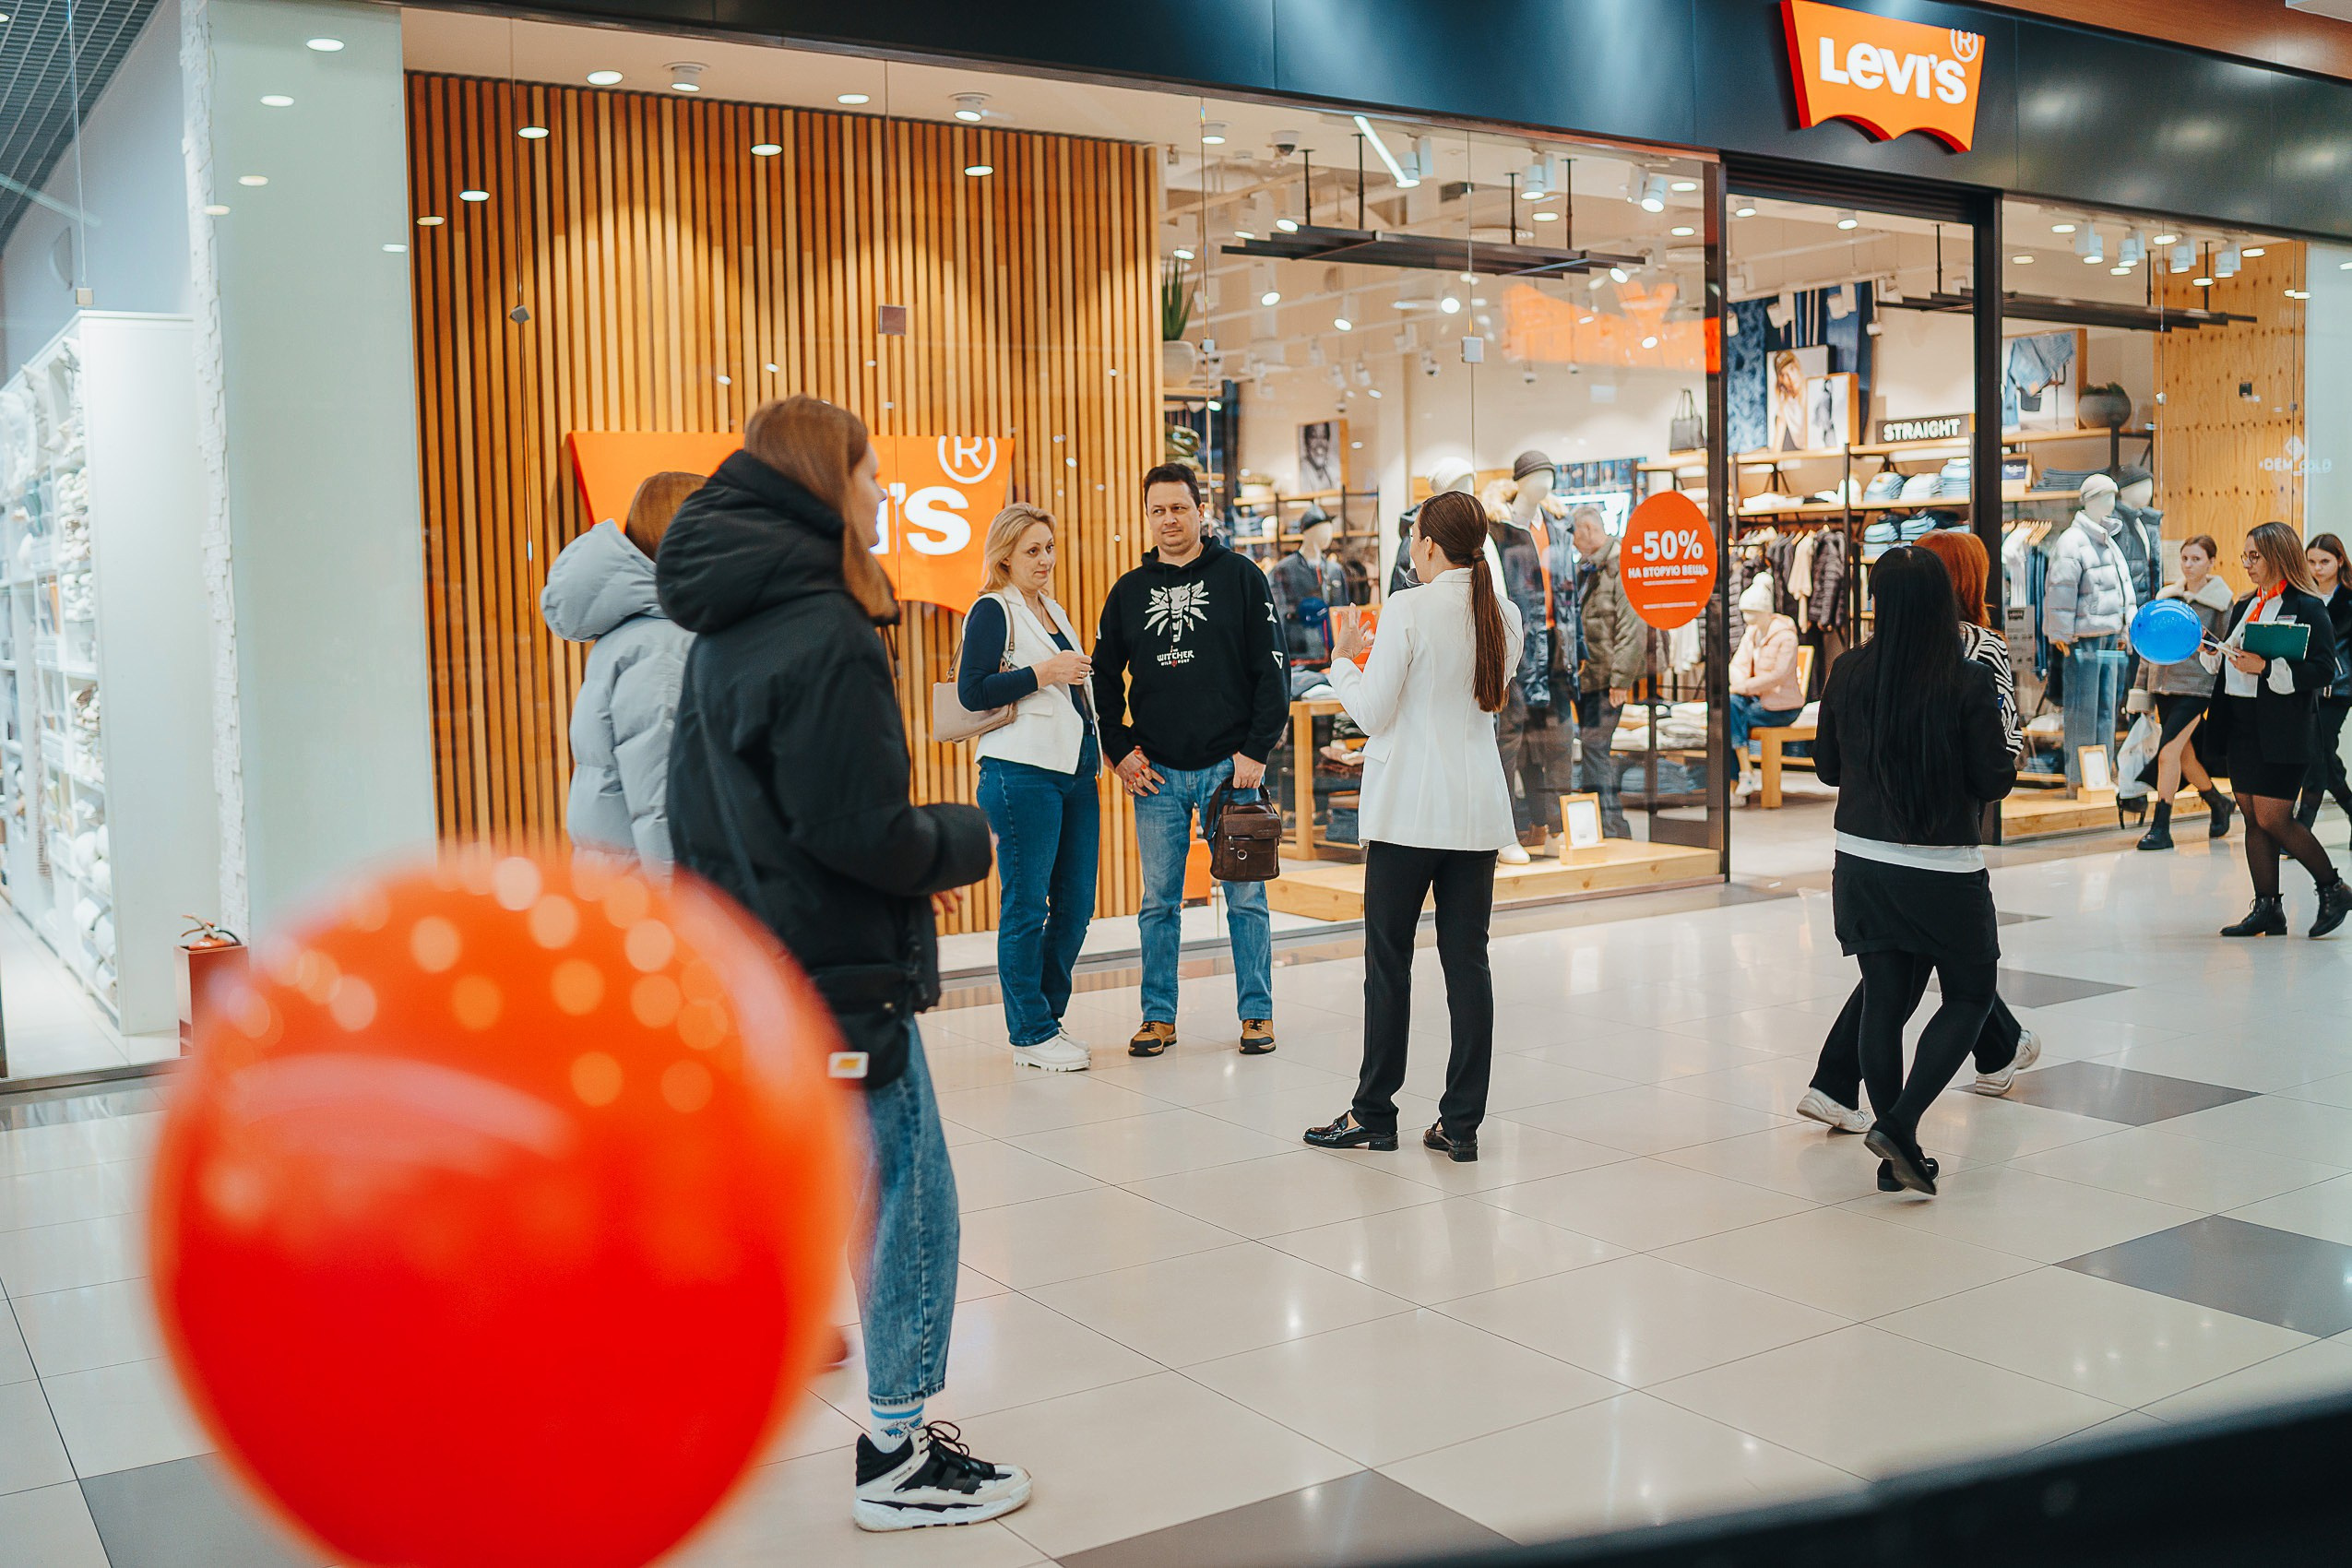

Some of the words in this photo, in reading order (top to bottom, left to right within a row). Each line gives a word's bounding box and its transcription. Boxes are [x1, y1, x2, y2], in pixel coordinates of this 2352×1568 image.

[1883, 418, 1961, 442] STRAIGHT
[1631, 529, 1705, 562] -50%
[1628, 567, 1642, 578] НА
[1643, 564, 1681, 578] ВТОРУЮ
[1681, 564, 1709, 577] ВЕЩЬ
[1157, 649, 1194, 662] WITCHER
